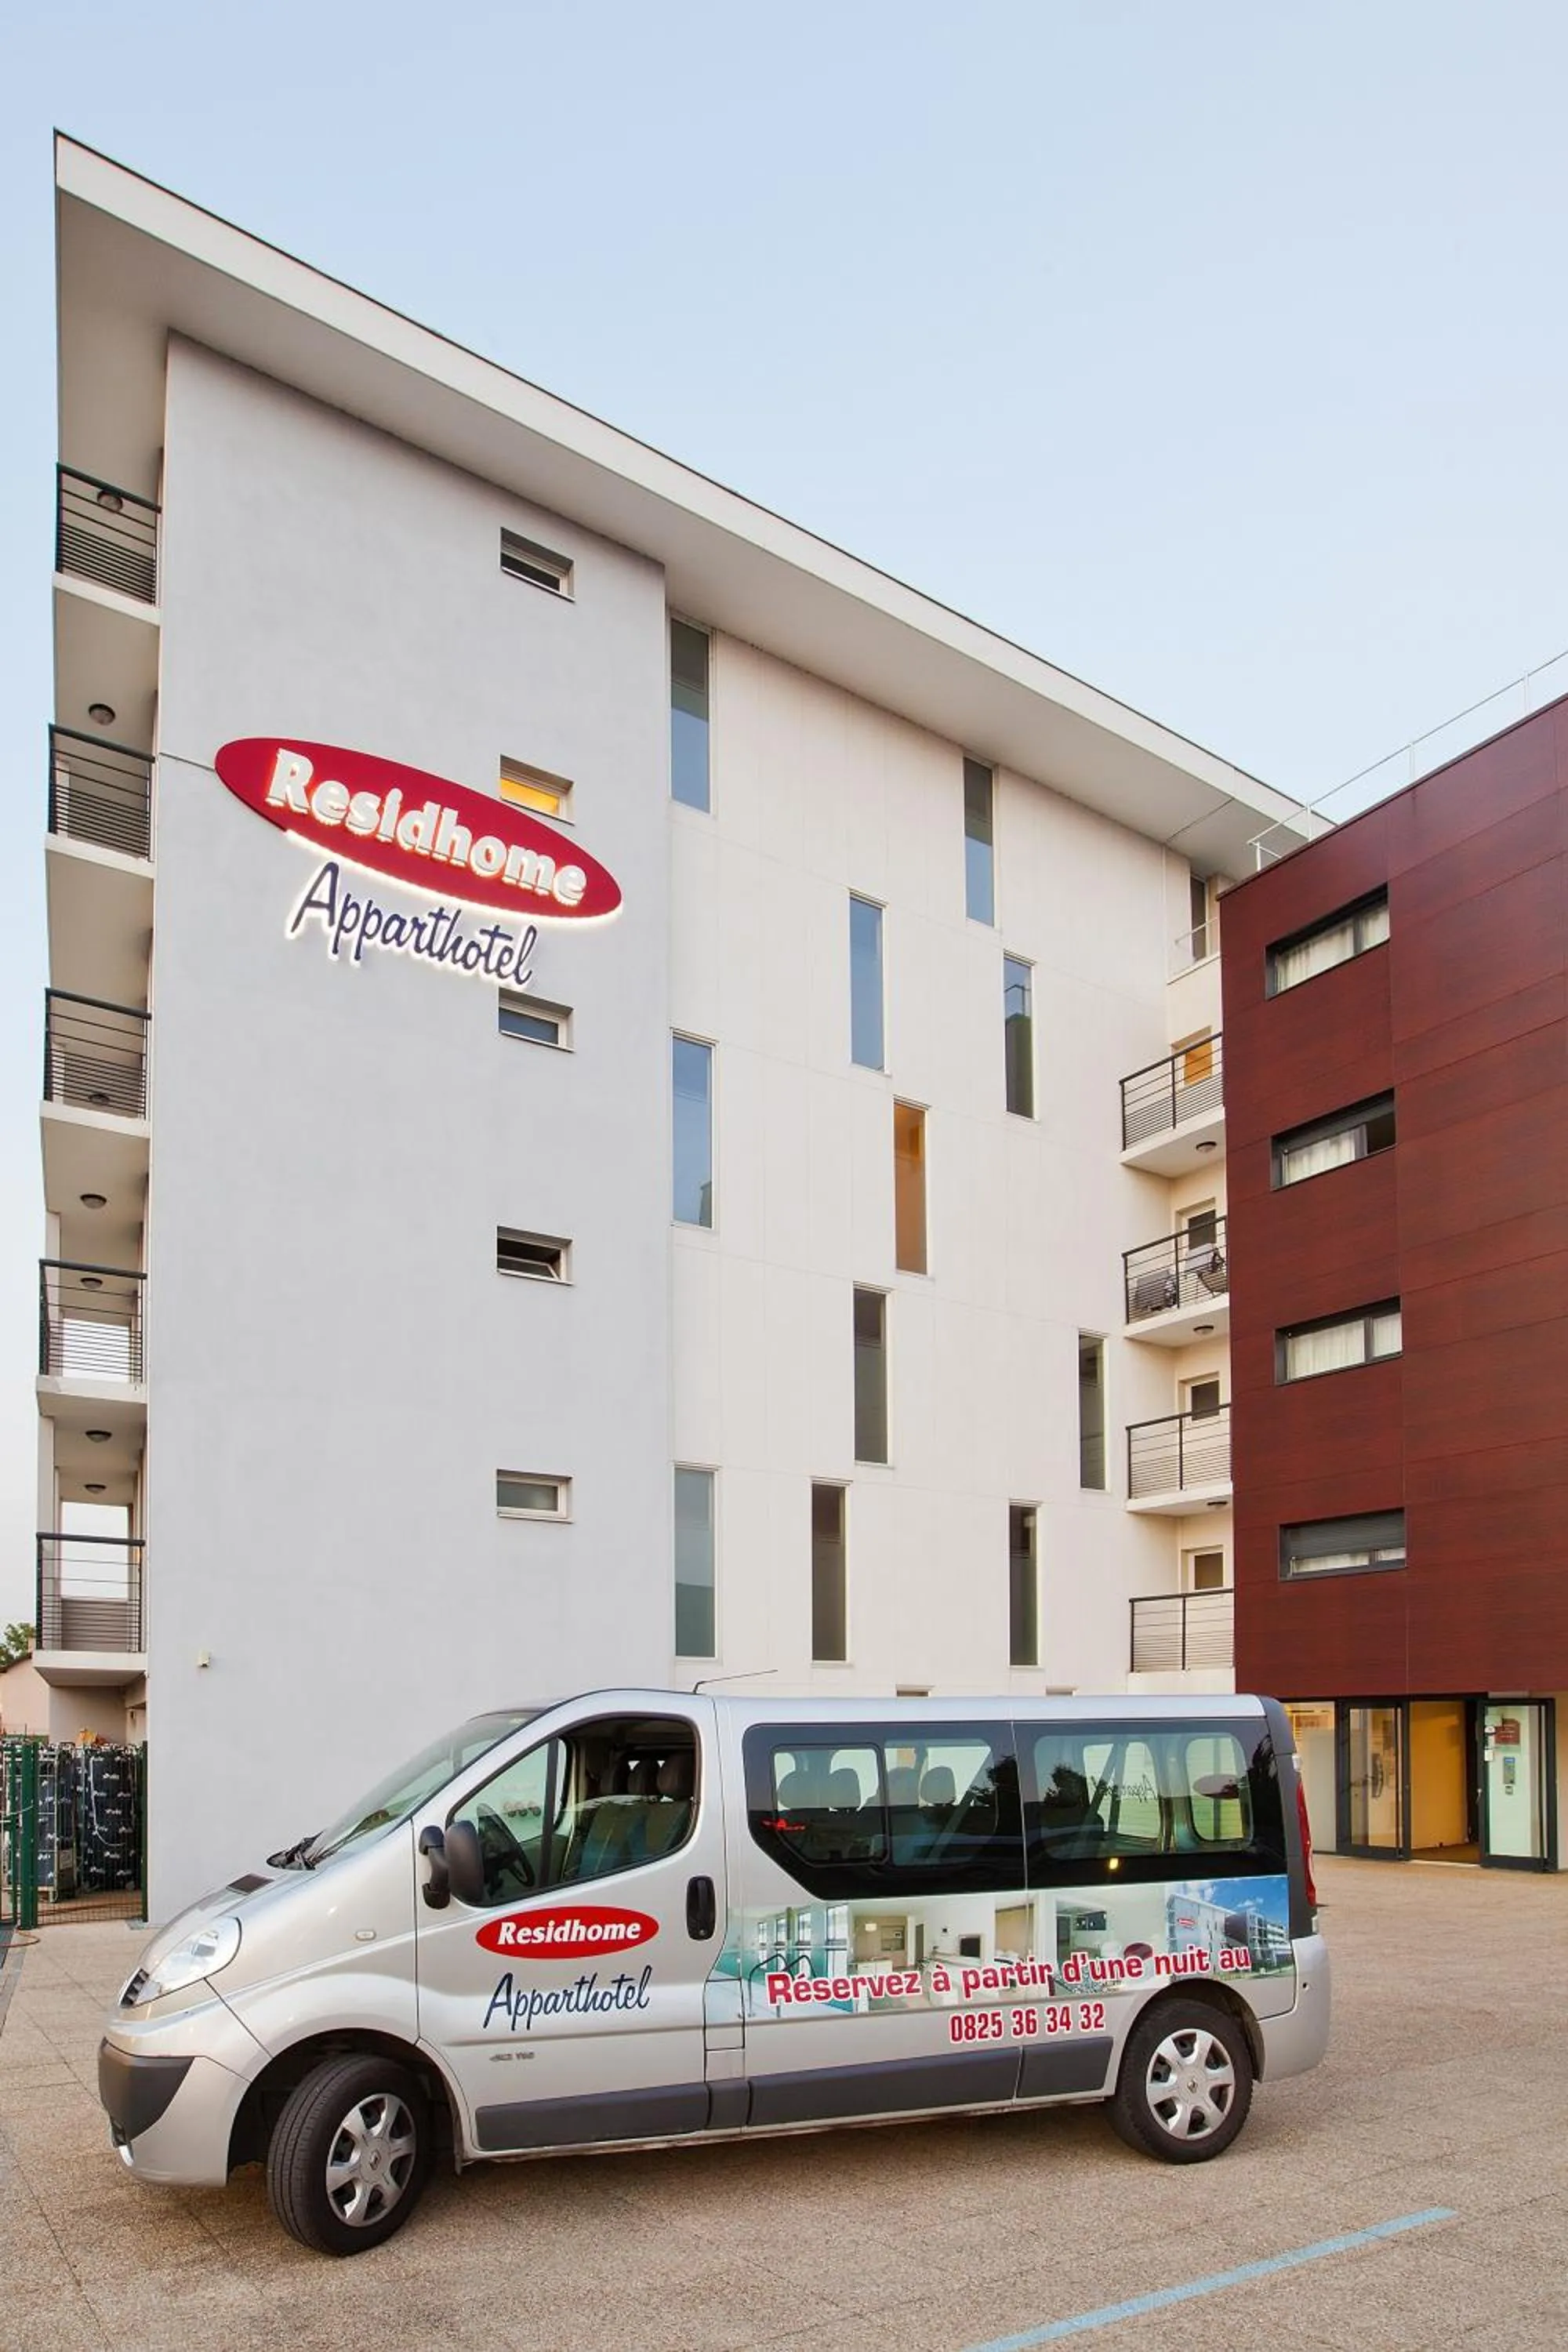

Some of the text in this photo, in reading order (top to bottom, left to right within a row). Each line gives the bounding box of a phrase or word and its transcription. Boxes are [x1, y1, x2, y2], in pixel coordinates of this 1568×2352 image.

[266, 749, 587, 905] Residhome
[290, 862, 538, 985] Apparthotel
[498, 1920, 641, 1945] Residhome
[483, 1965, 653, 2031] Apparthotel
[767, 1972, 922, 2005] Réservez
[932, 1964, 950, 1992] à
[961, 1955, 1054, 1998] partir
[1155, 1945, 1211, 1976] nuit
[1220, 1947, 1252, 1971] au
[949, 2003, 1105, 2043] 0825 36 34 32
